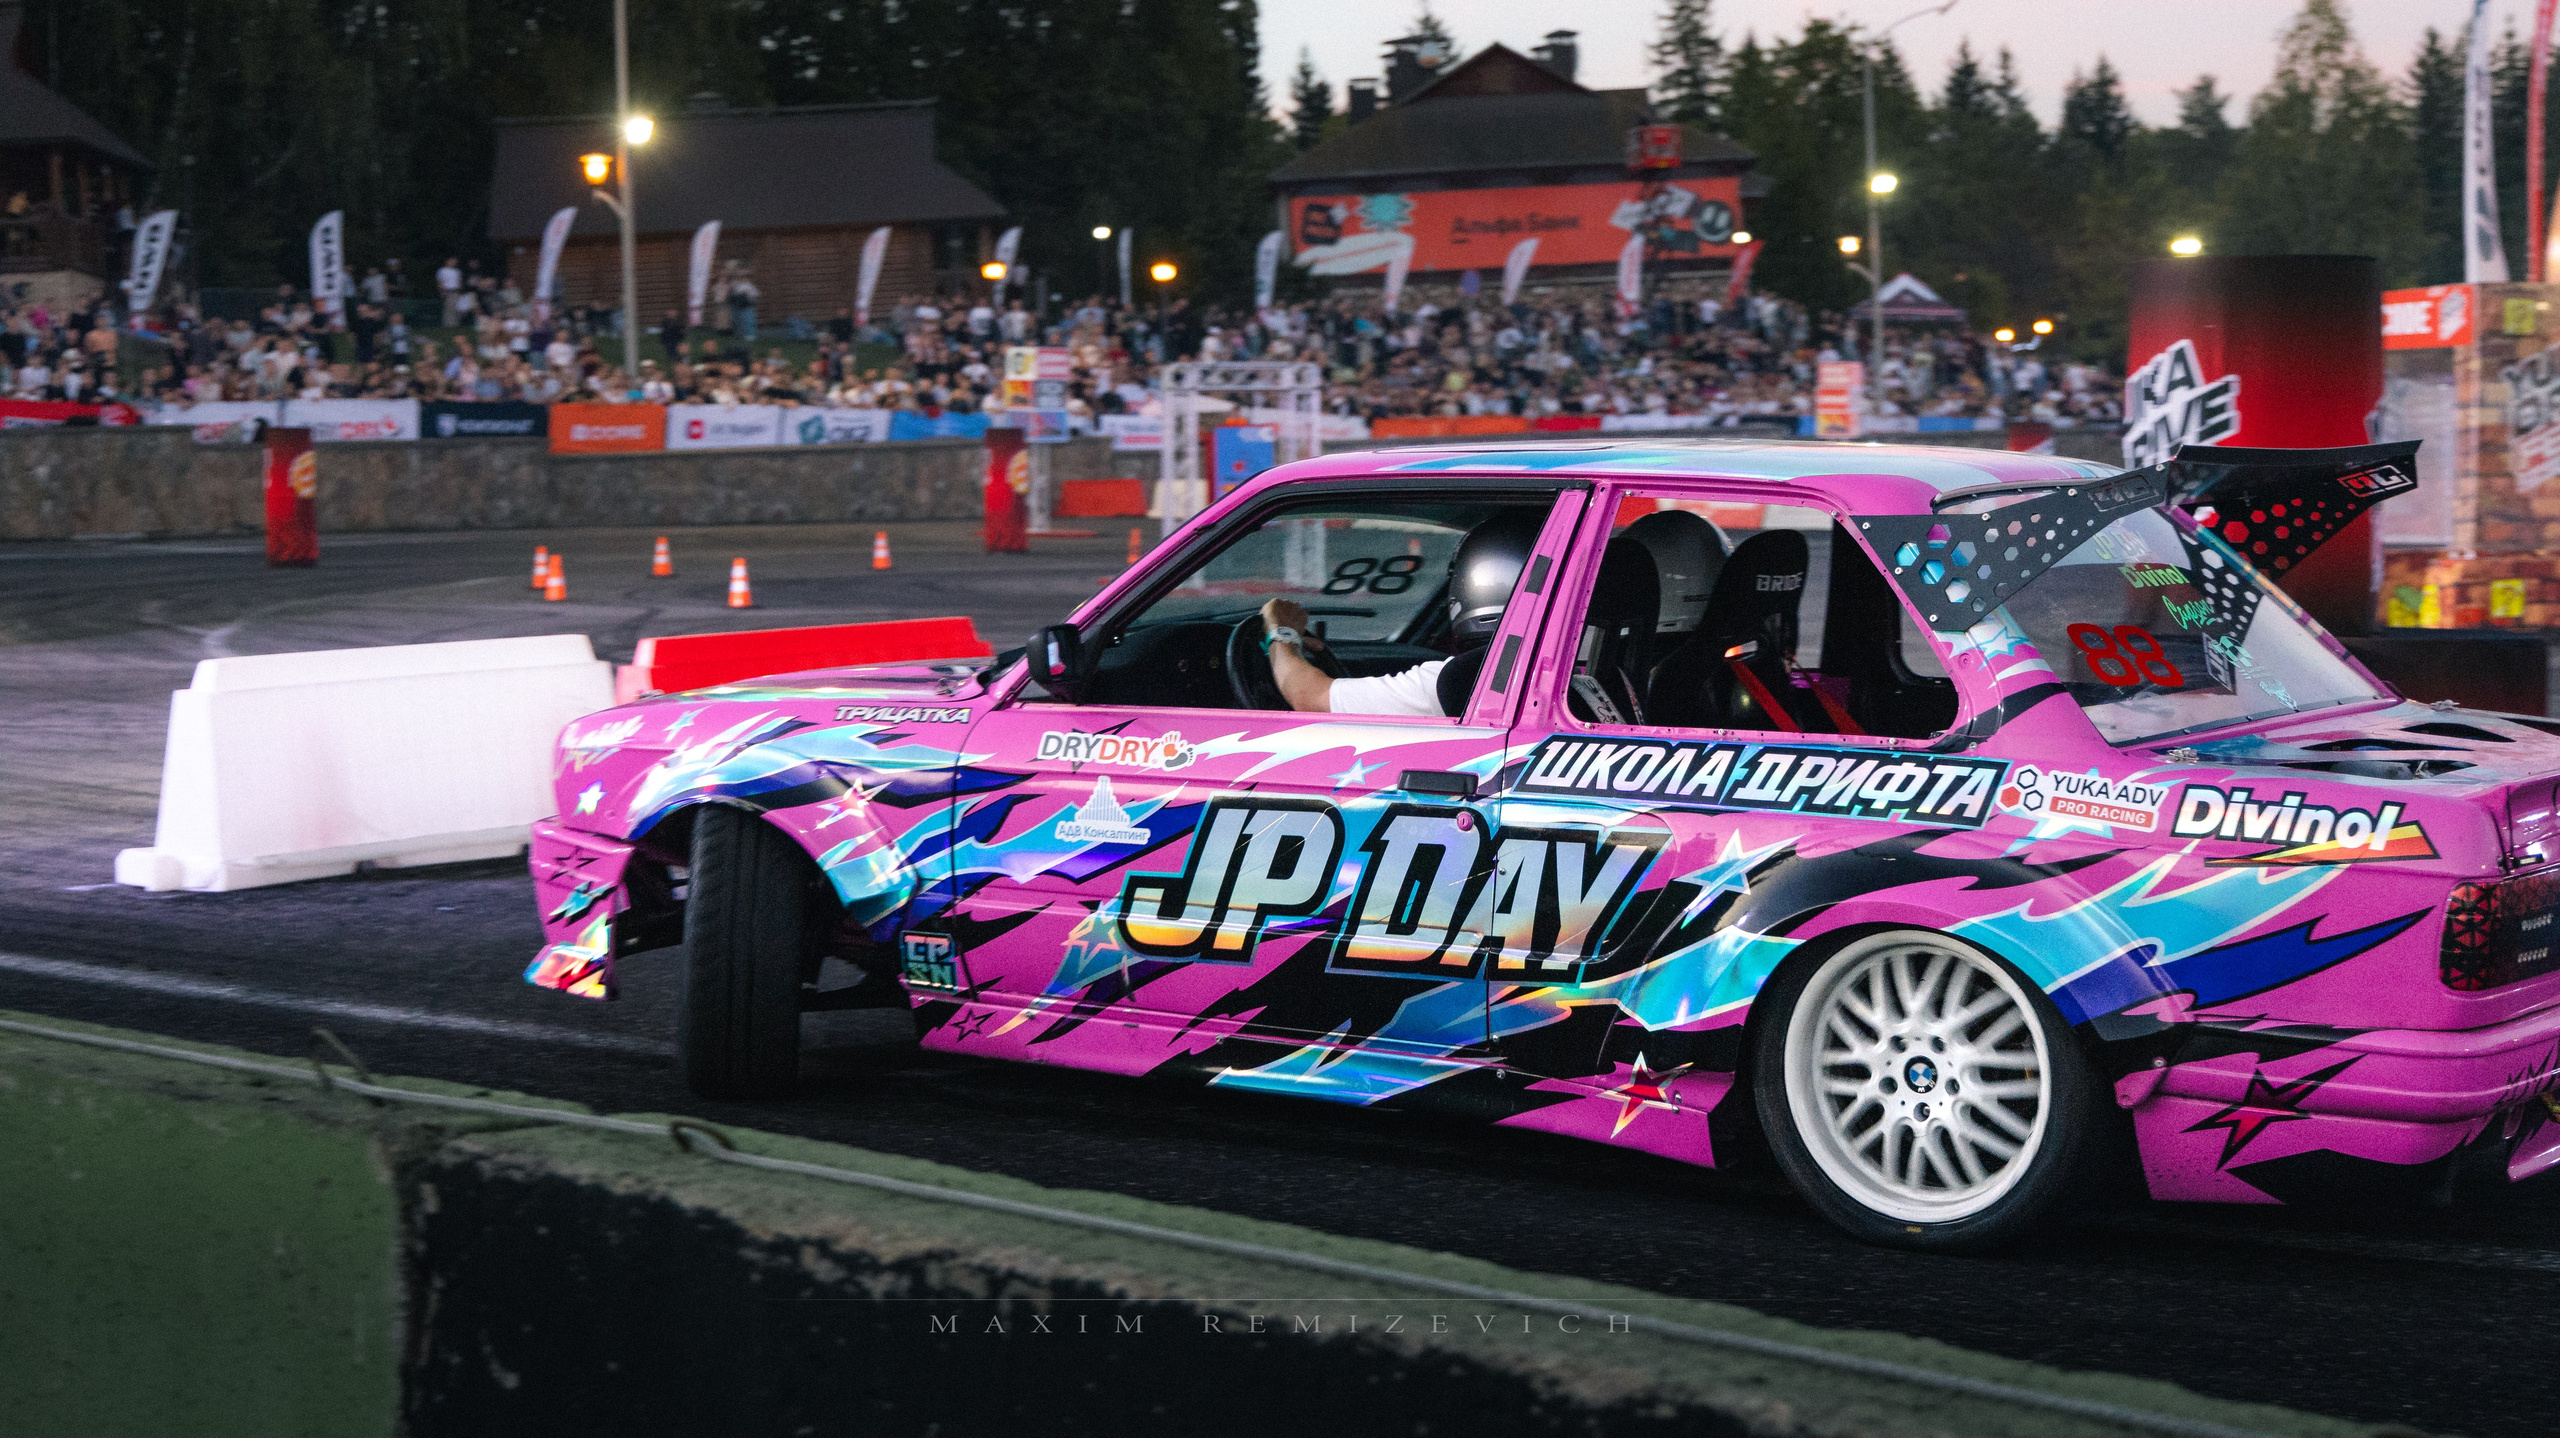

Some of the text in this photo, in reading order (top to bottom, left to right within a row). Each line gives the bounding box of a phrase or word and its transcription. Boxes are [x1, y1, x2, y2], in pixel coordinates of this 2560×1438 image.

[1322, 555, 1424, 596] 88
[2117, 562, 2190, 589] Divinol
[2066, 622, 2185, 687] 88
[834, 704, 972, 724] ТРИЦАТКА
[1525, 740, 1998, 819] ШКОЛА ДРИФТА
[2053, 774, 2164, 807] YUKA ADV
[2056, 800, 2147, 824] PRO RACING
[2173, 786, 2402, 852] Divinol
[1058, 823, 1148, 842] АДВ Консалтинг
[1126, 804, 1650, 973] JP DAY
